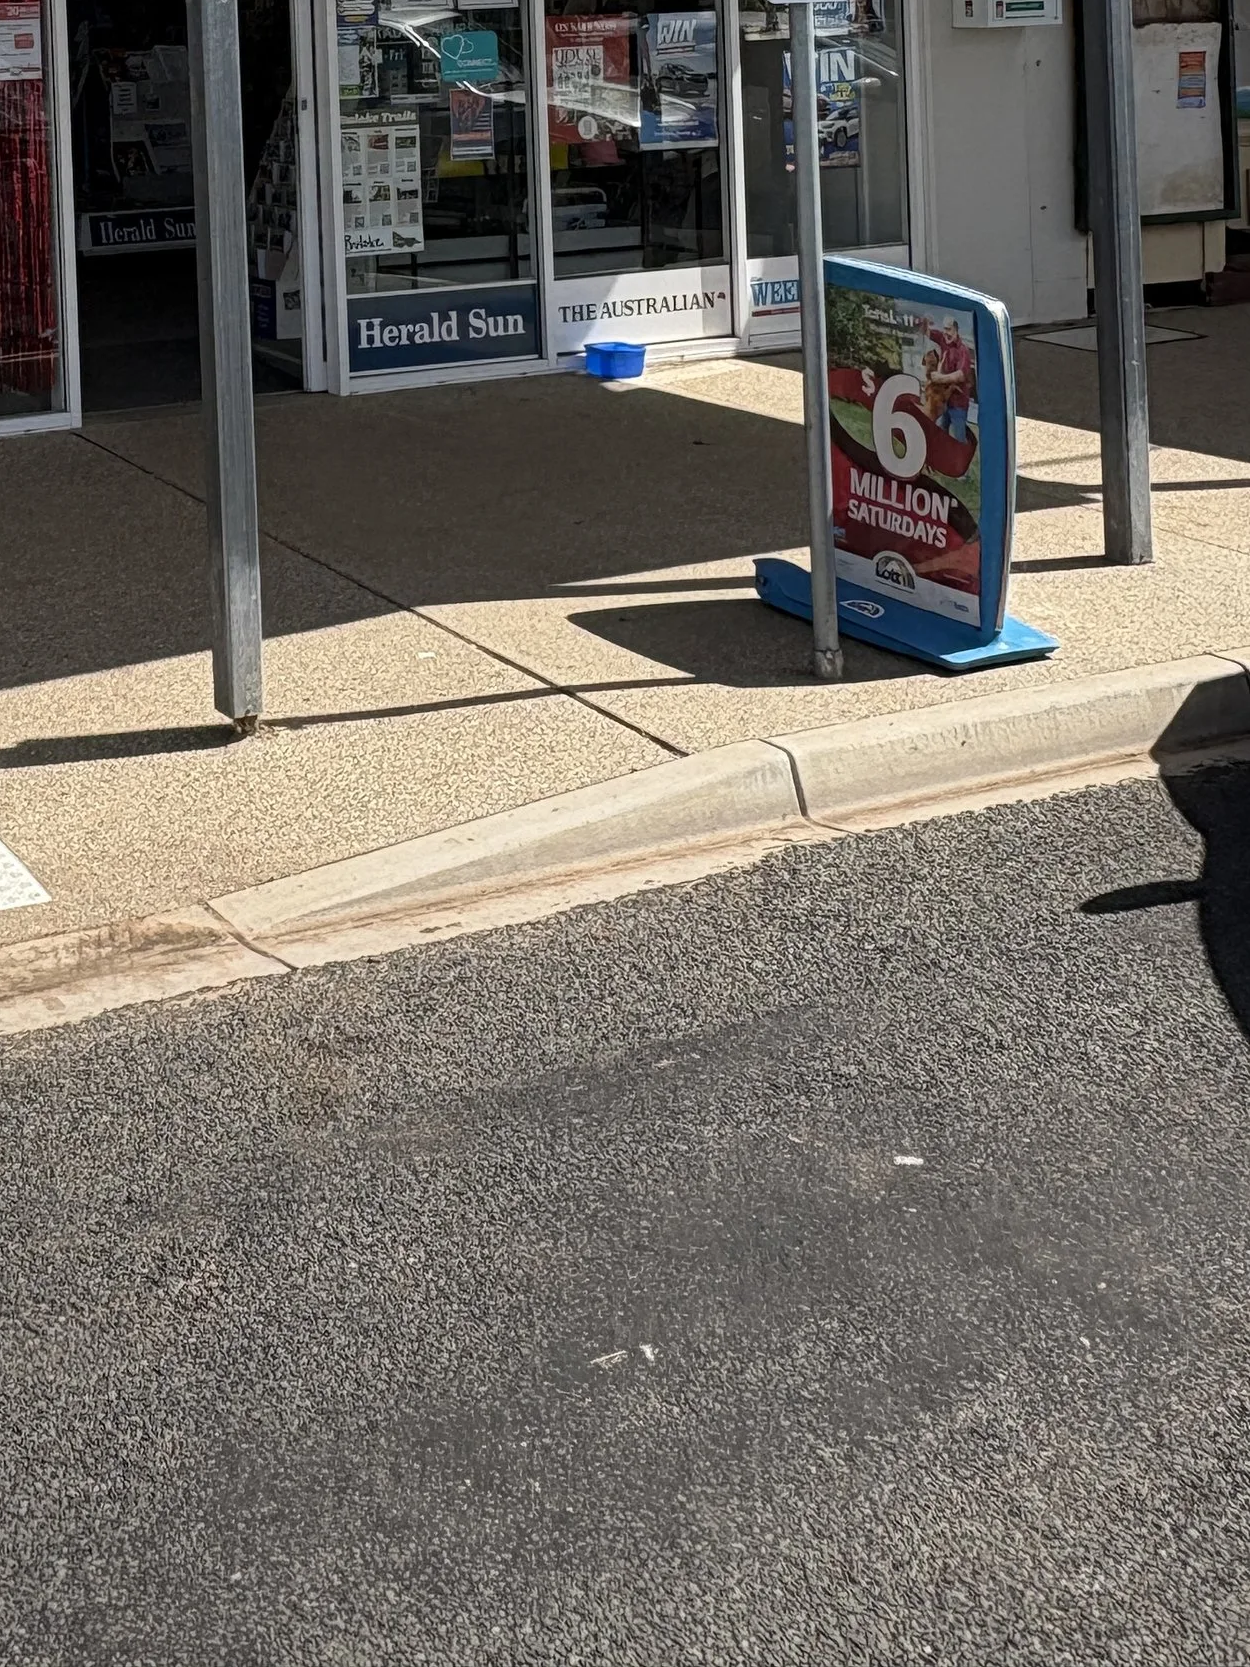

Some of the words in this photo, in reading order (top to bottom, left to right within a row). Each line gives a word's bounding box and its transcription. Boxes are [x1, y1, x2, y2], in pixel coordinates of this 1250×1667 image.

[657, 19, 696, 45] WIN
[100, 218, 156, 243] Herald
[164, 217, 196, 238] Sun
[558, 303, 597, 323] THE
[600, 291, 715, 319] AUSTRALIAN
[750, 279, 801, 307] WEE
[357, 310, 459, 349] Herald
[468, 308, 525, 338] Sun
[848, 499, 947, 549] SATURDAYS
